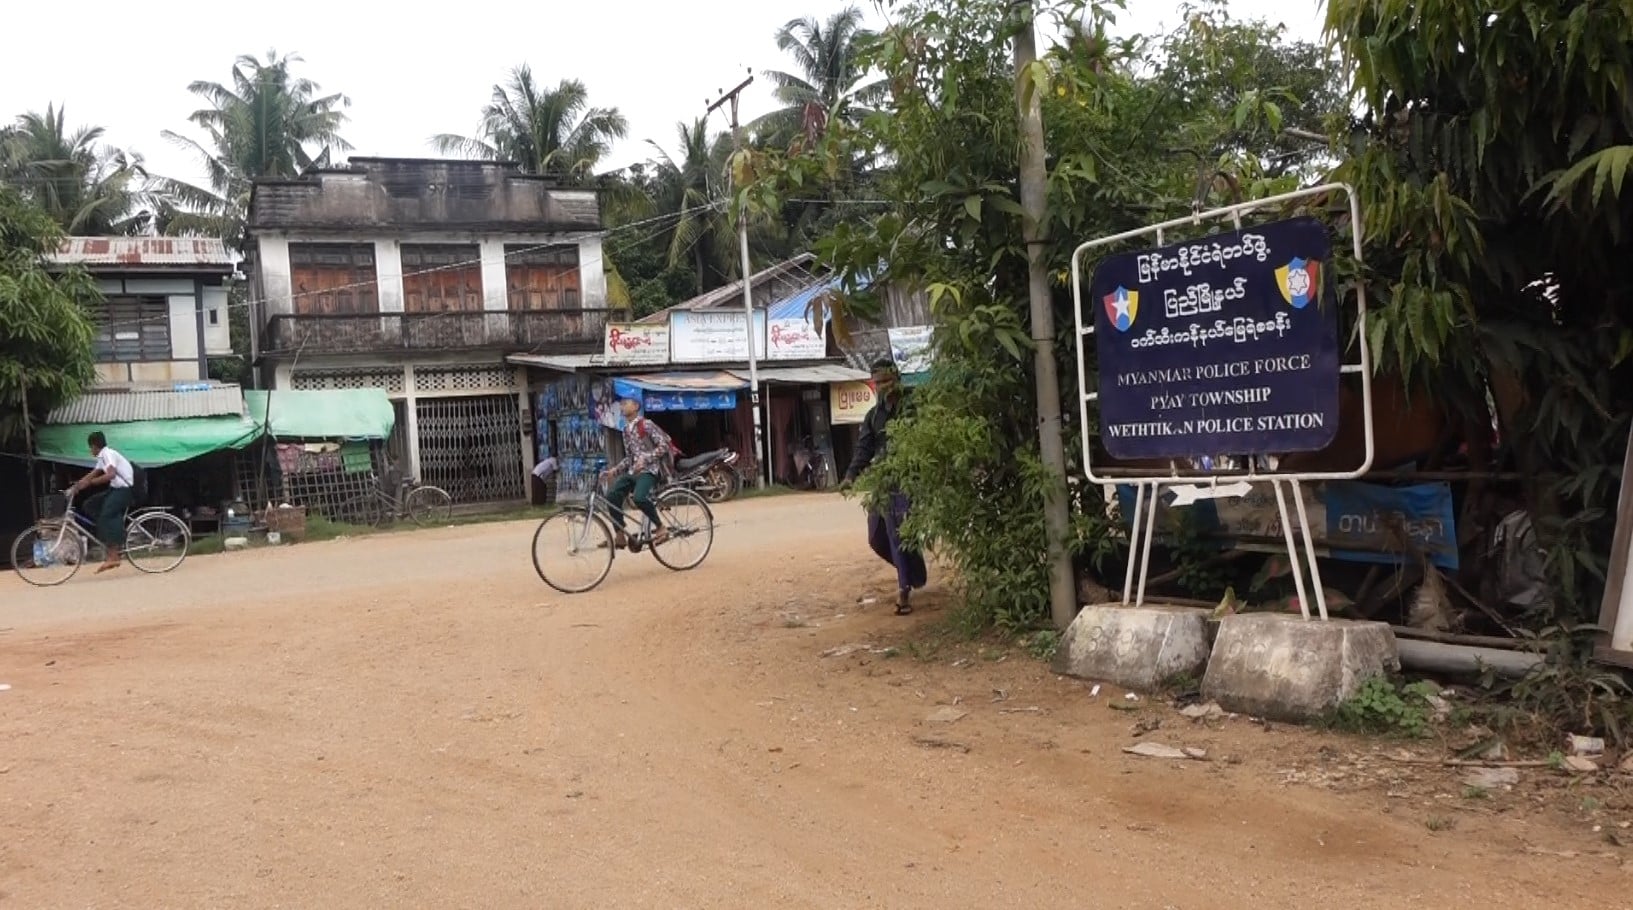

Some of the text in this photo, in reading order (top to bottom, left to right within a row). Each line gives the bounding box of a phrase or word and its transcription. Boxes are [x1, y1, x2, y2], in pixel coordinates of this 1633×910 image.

[1117, 354, 1312, 386] MYANMAR POLICE FORCE
[1151, 387, 1271, 410] PYAY TOWNSHIP
[1197, 416, 1253, 435] POLICE
[1256, 412, 1324, 432] STATION
